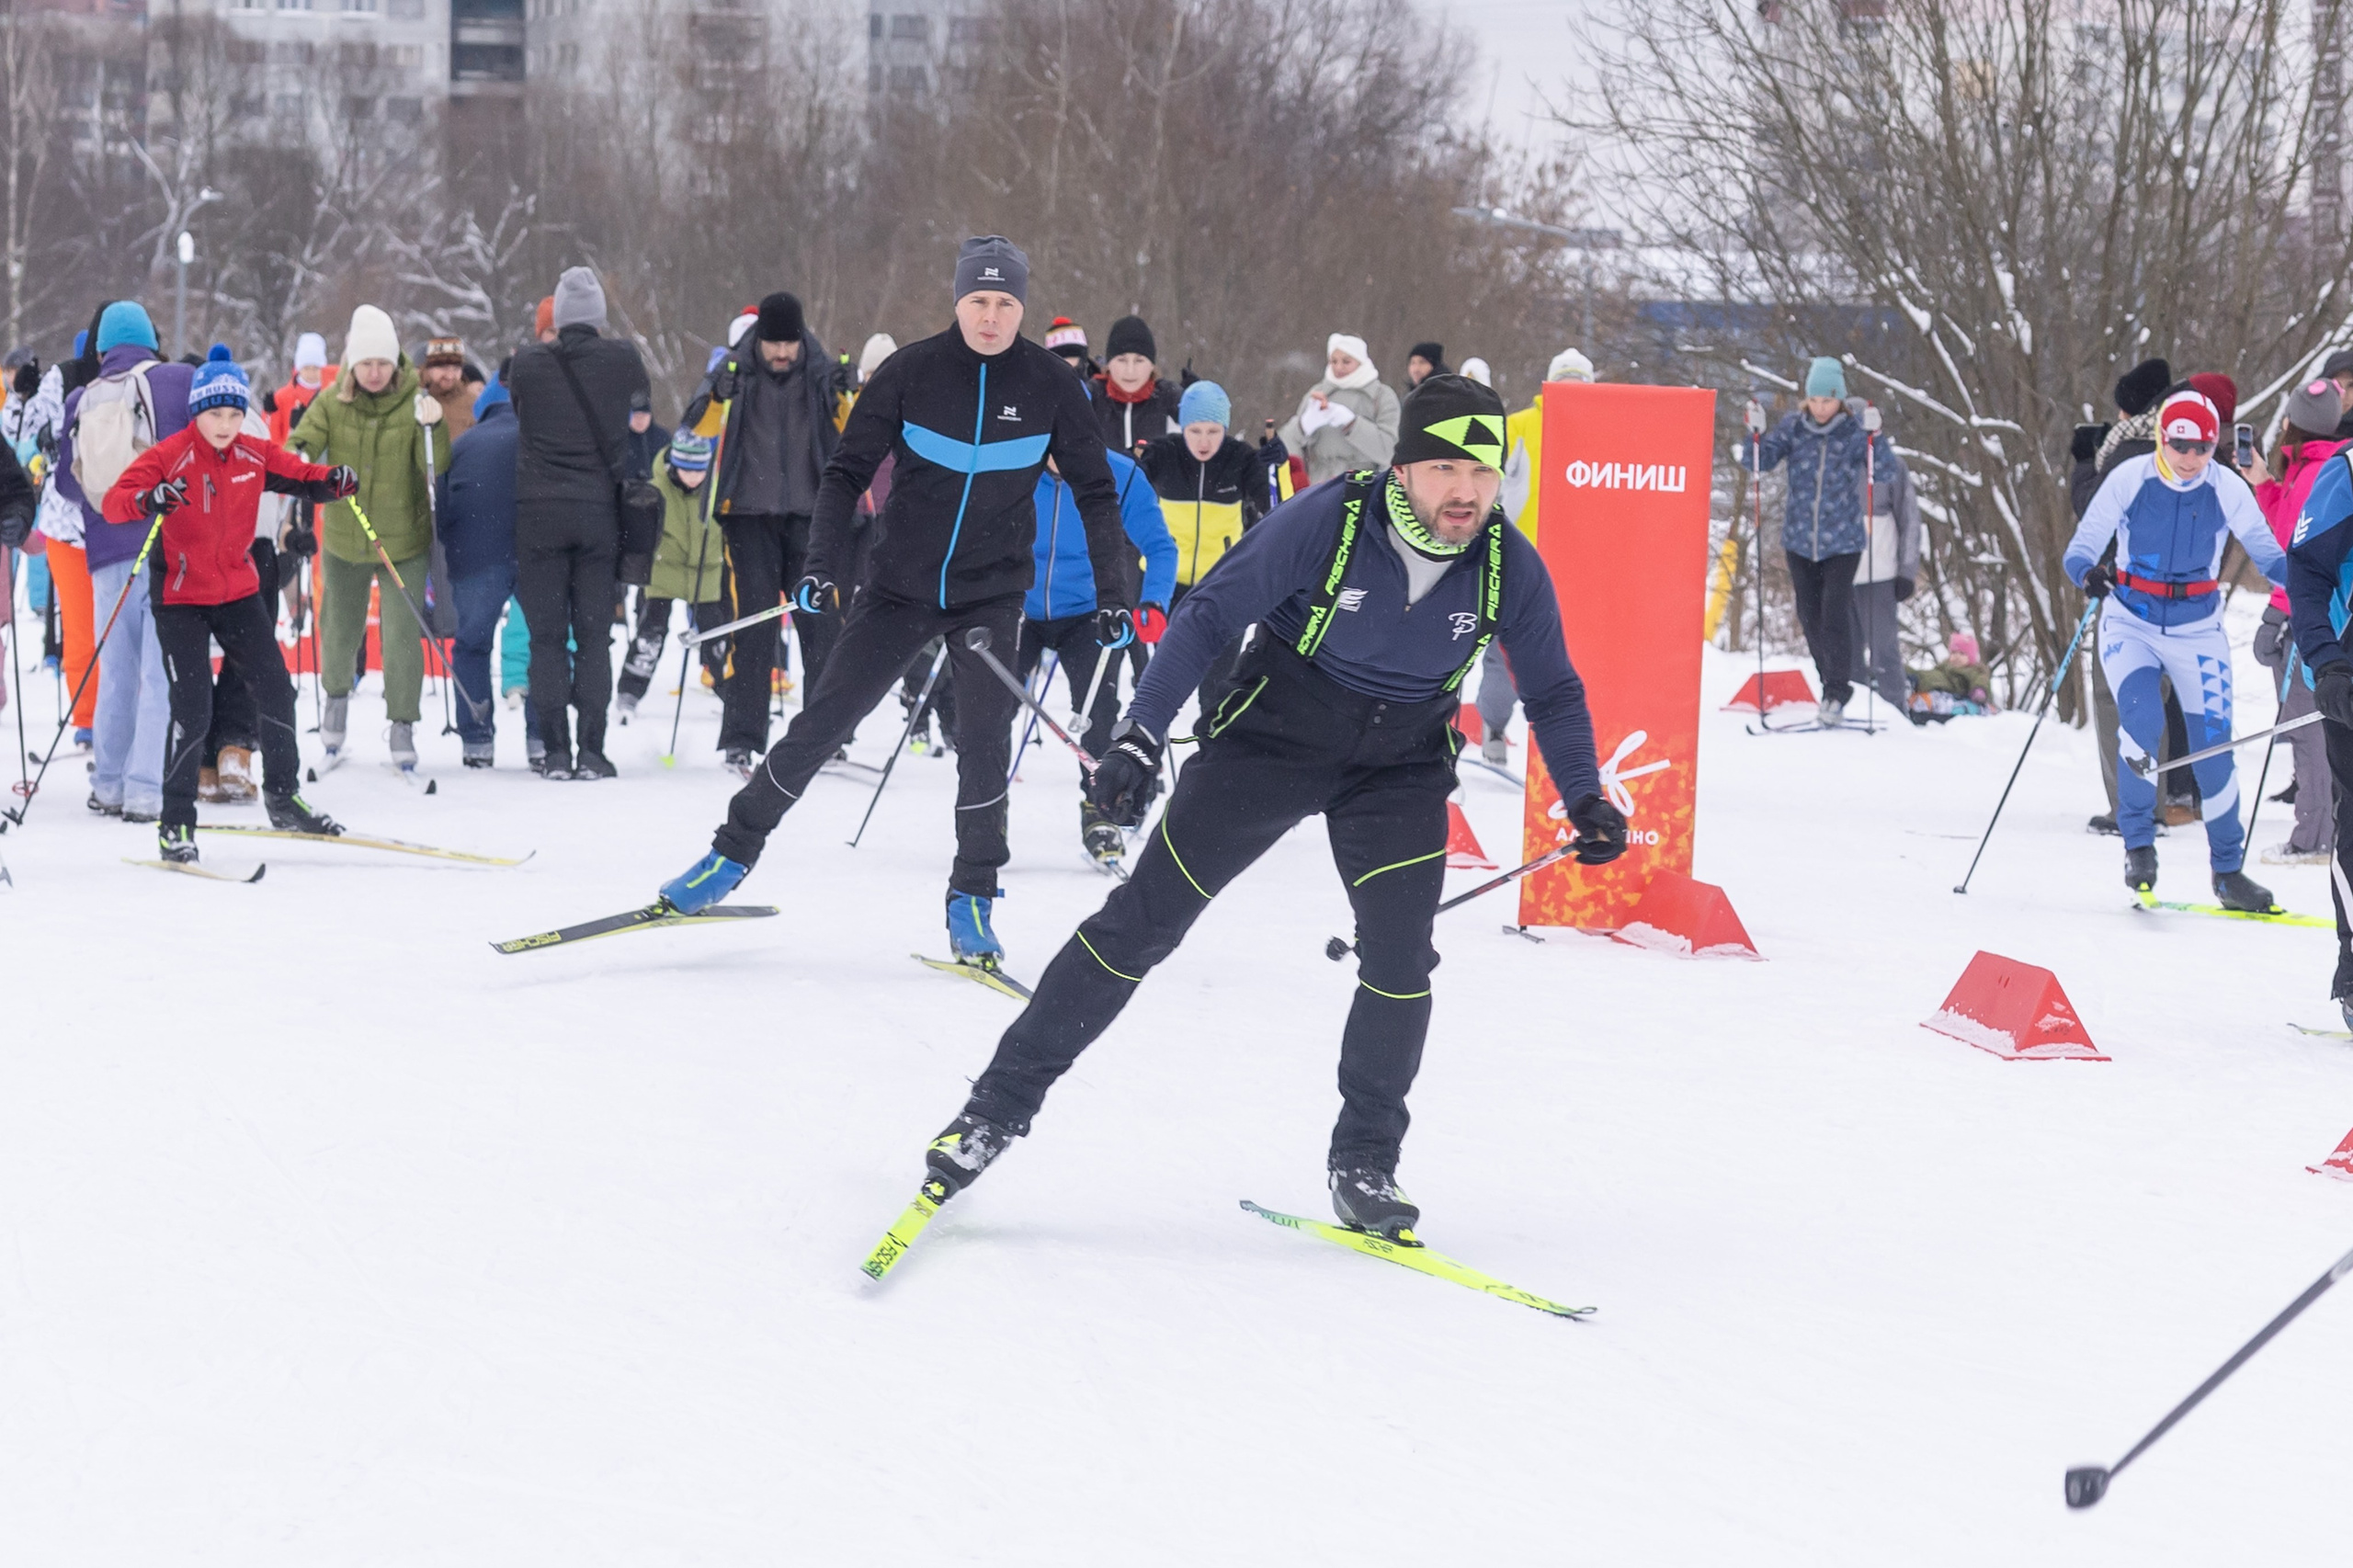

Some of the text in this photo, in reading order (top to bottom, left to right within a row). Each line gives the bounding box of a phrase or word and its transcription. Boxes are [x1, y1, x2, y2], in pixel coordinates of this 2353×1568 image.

[1565, 460, 1686, 493] ФИНИШ
[1324, 512, 1358, 597] FISCHER
[1486, 538, 1502, 621] FISCHER
[502, 930, 562, 952] FISCHER
[866, 1240, 899, 1278] FISCHER
